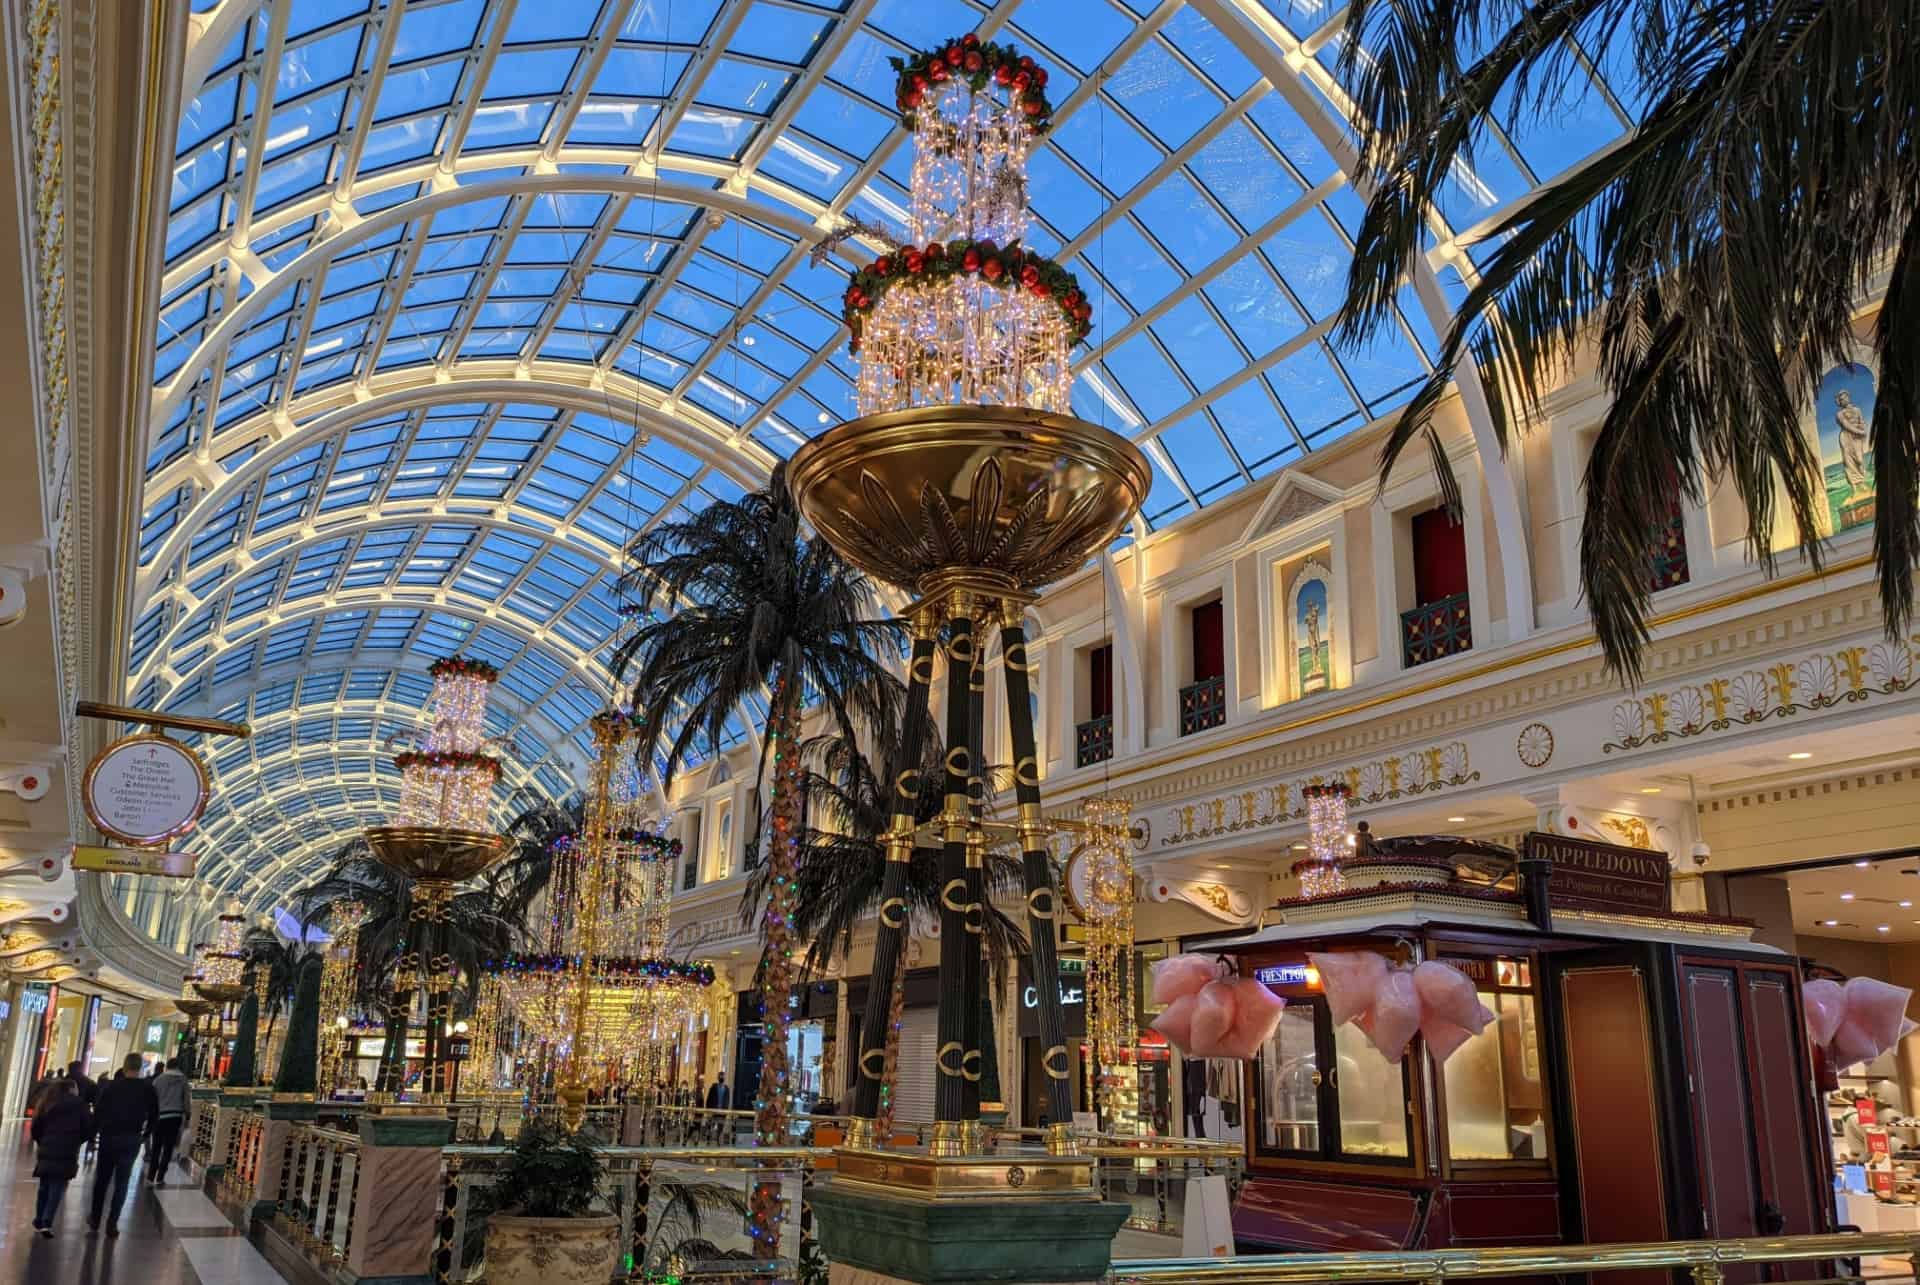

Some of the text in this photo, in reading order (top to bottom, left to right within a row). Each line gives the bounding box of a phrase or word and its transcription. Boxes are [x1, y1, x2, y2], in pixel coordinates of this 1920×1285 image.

[122, 772, 136, 781] The
[1535, 842, 1662, 878] DAPPLEDOWN
[21, 991, 49, 1014] TOPSHOP
